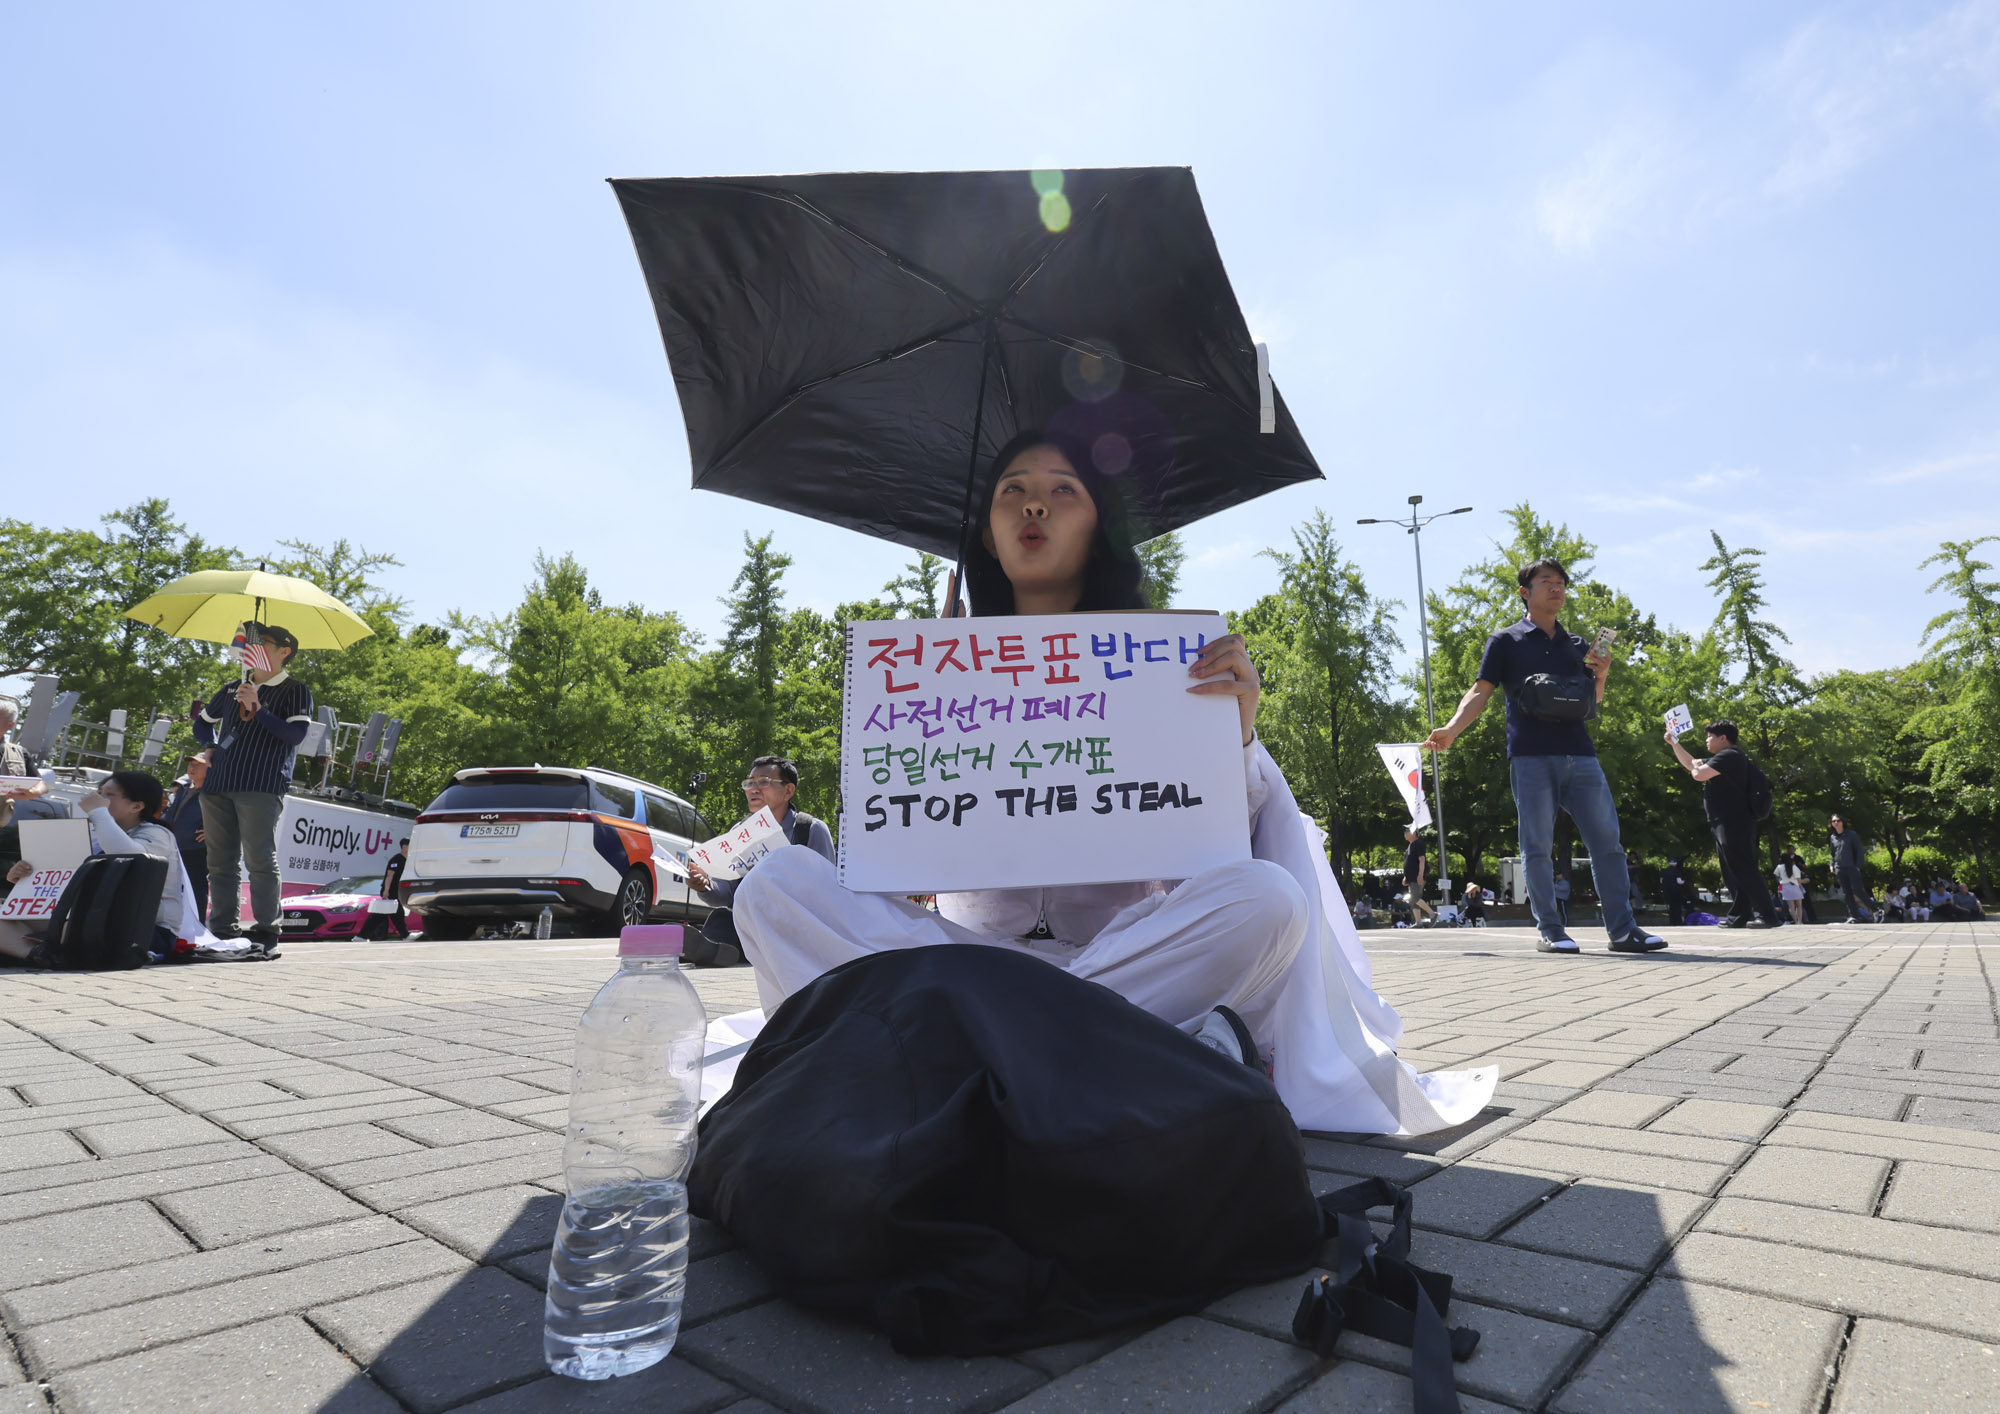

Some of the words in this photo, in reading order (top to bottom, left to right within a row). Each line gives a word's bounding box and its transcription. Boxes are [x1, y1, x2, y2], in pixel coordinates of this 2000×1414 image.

[862, 742, 995, 786] 당일선거
[1009, 737, 1115, 779] 수개표
[864, 793, 978, 832] STOP
[995, 784, 1078, 818] THE
[1090, 782, 1202, 815] STEAL
[293, 817, 361, 856] Simply.
[365, 828, 393, 855] U+
[32, 870, 73, 886] STOP
[33, 886, 60, 898] THE
[2, 898, 57, 916] STEA
